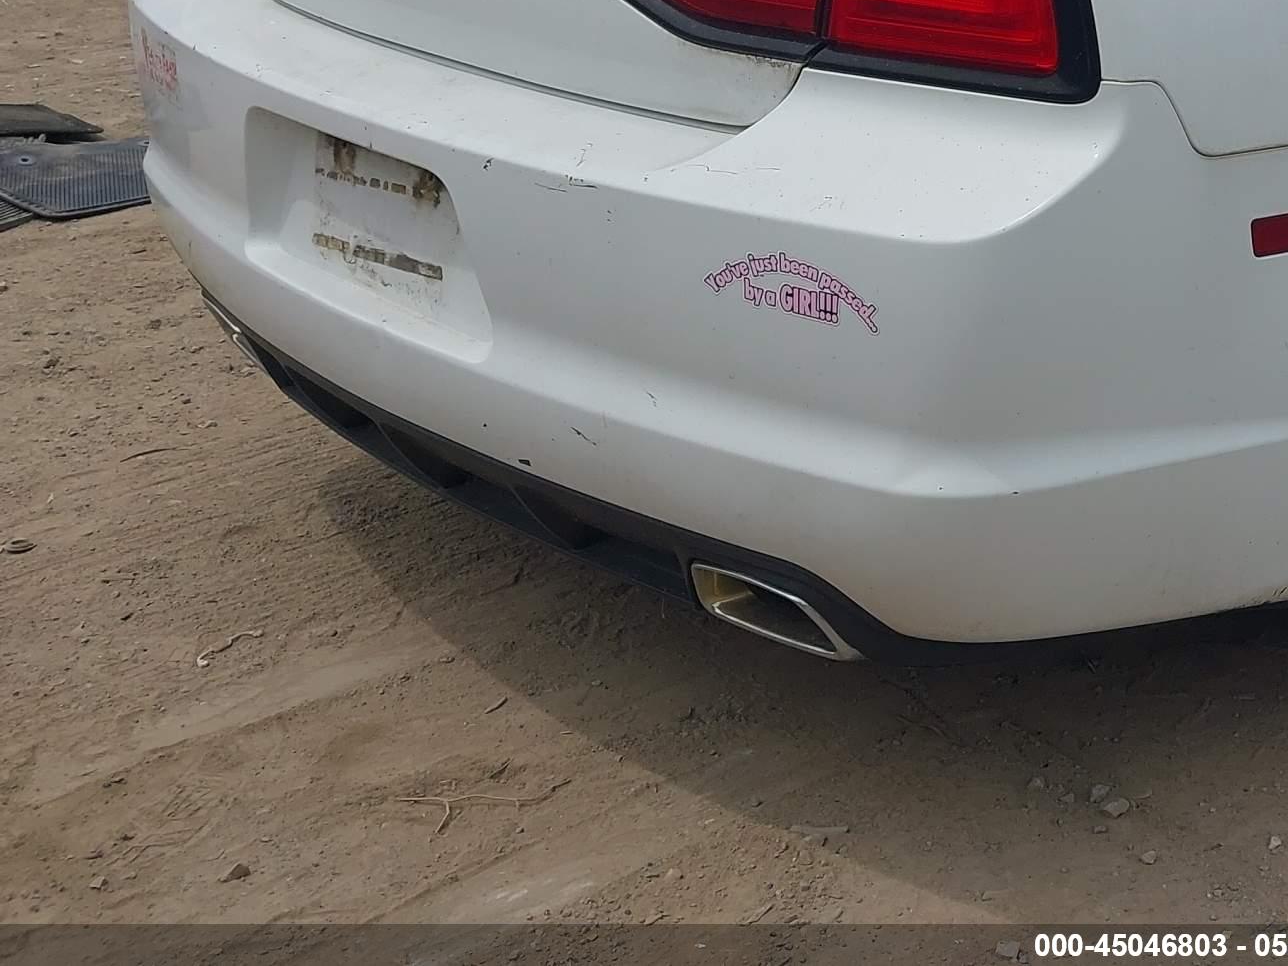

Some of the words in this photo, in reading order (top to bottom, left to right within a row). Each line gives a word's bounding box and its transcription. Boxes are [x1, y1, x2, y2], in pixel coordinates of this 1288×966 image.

[704, 262, 750, 293] You've
[748, 253, 778, 277] just
[779, 252, 819, 282] been
[744, 277, 763, 306] by
[765, 290, 776, 307] a
[780, 284, 839, 323] GIRL!!!
